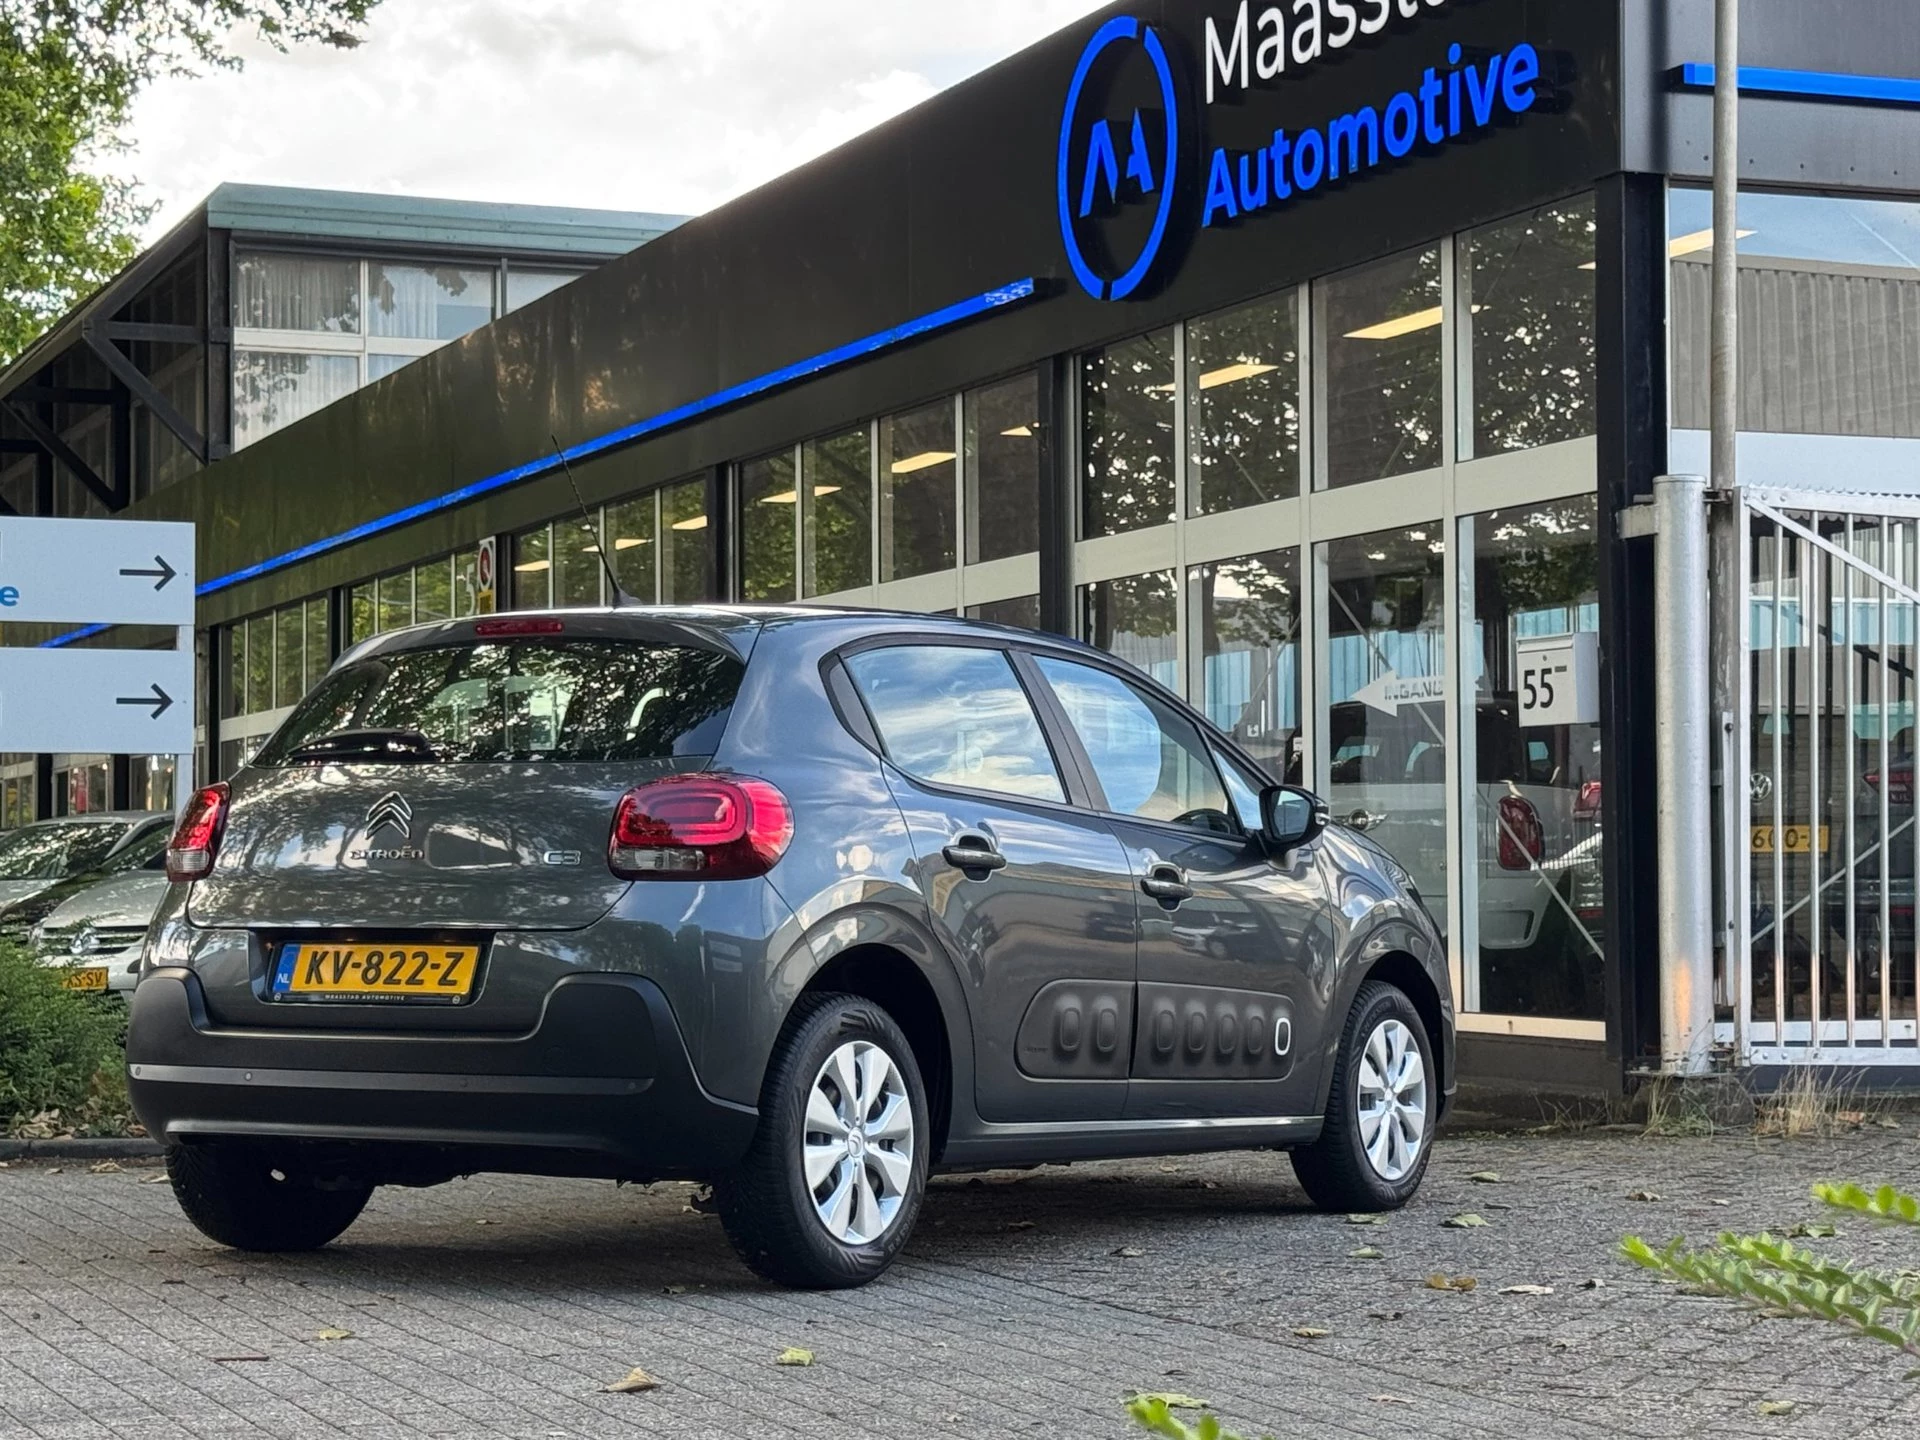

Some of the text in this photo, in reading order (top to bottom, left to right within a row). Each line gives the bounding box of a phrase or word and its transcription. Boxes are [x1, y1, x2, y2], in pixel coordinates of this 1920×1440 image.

[1205, 0, 1445, 104] Maass
[1202, 43, 1540, 228] Automotive
[1523, 667, 1554, 710] 55
[543, 850, 582, 865] C3
[276, 973, 290, 984] NL
[304, 950, 465, 986] KV-822-Z
